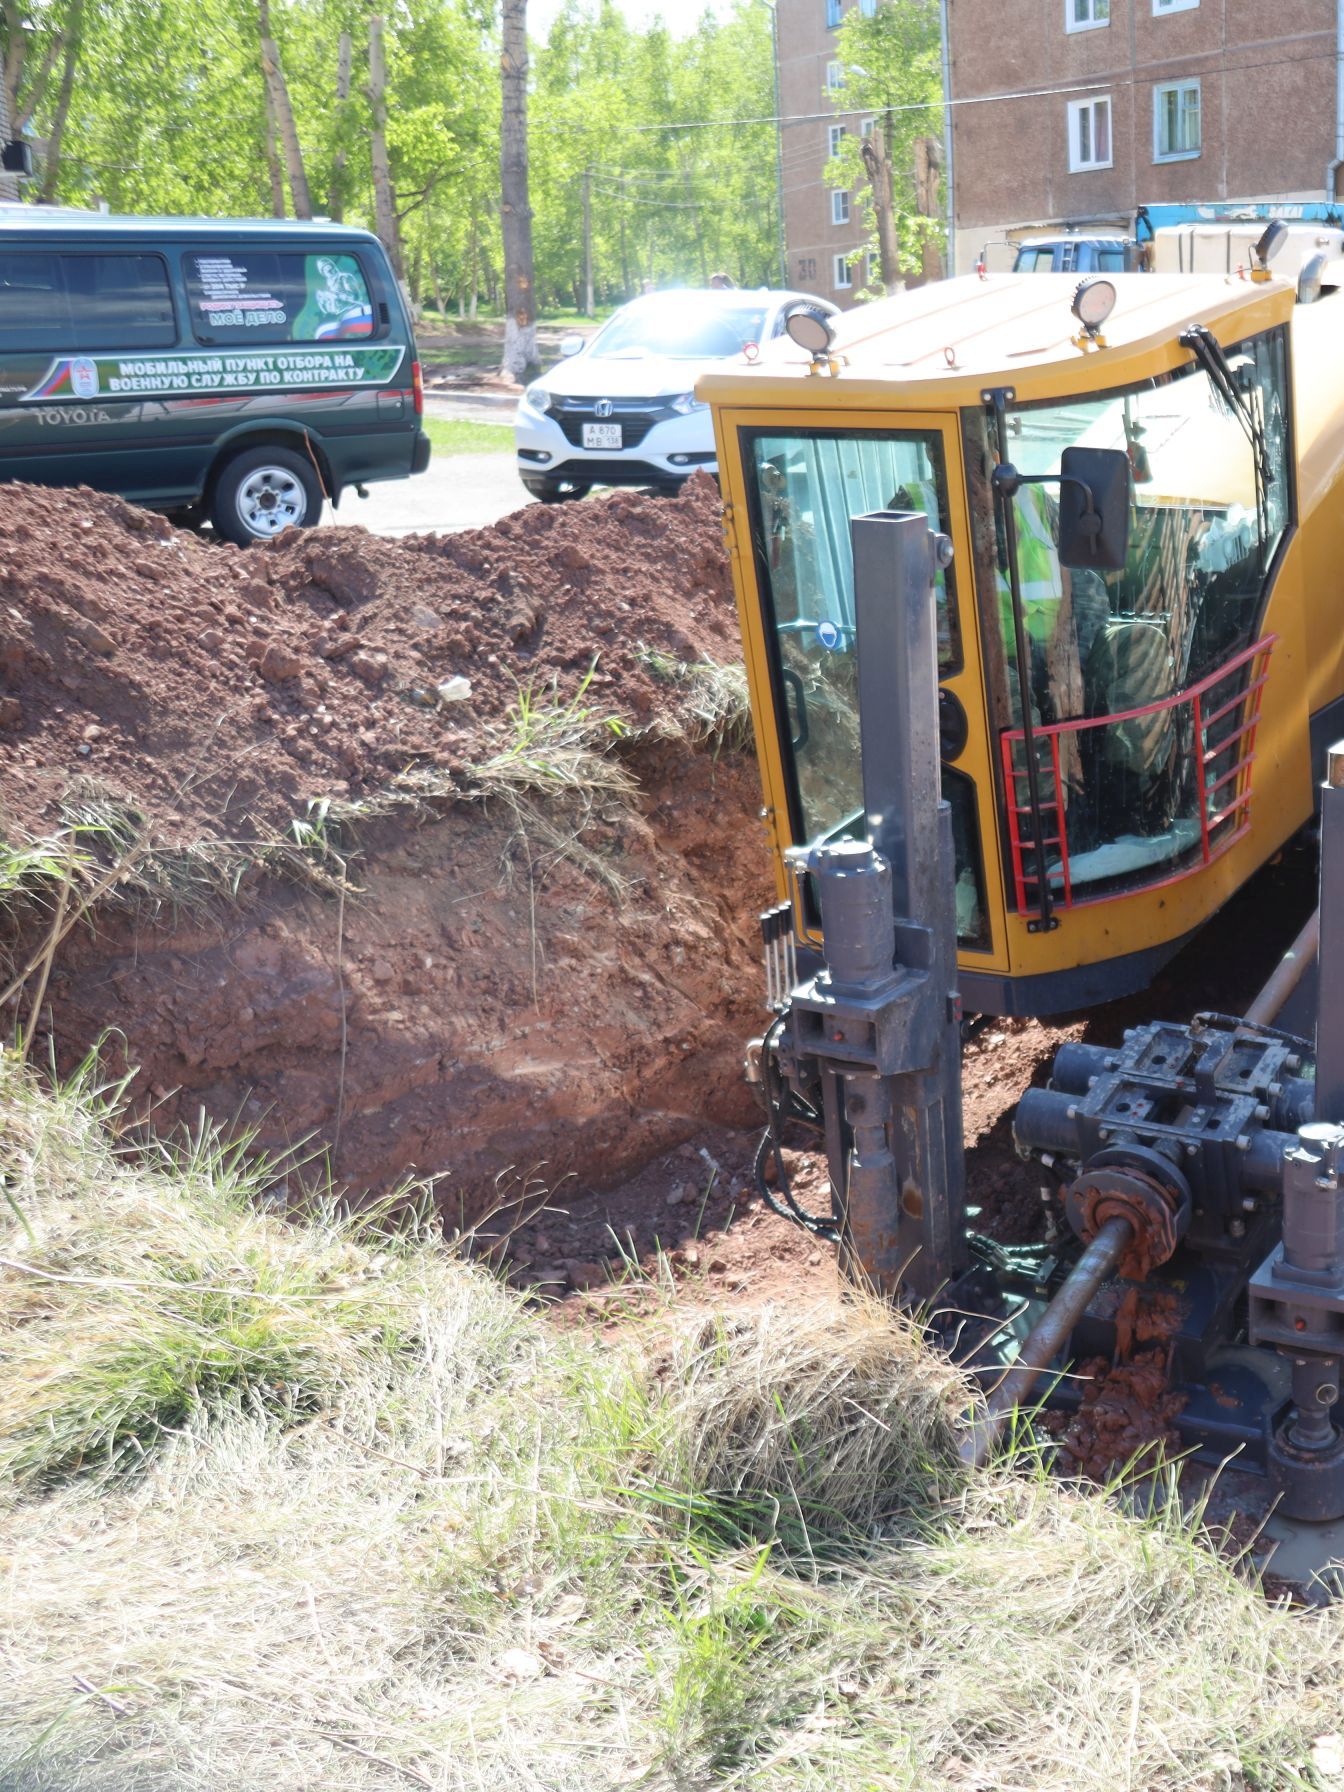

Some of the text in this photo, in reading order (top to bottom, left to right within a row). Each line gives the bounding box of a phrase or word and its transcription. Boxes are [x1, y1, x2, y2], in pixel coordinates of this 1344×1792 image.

[798, 258, 816, 281] 30
[245, 310, 287, 326] ДЕЛО
[119, 354, 355, 376] МОБИЛЬНЫЙ ПУНКТ ОТБОРА НА
[109, 374, 188, 391] ВОЕННУЮ
[191, 371, 257, 388] СЛУЖБУ
[260, 371, 281, 384] ПО
[283, 367, 365, 384] КОНТРАКТУ
[35, 408, 112, 426] TOYOTA
